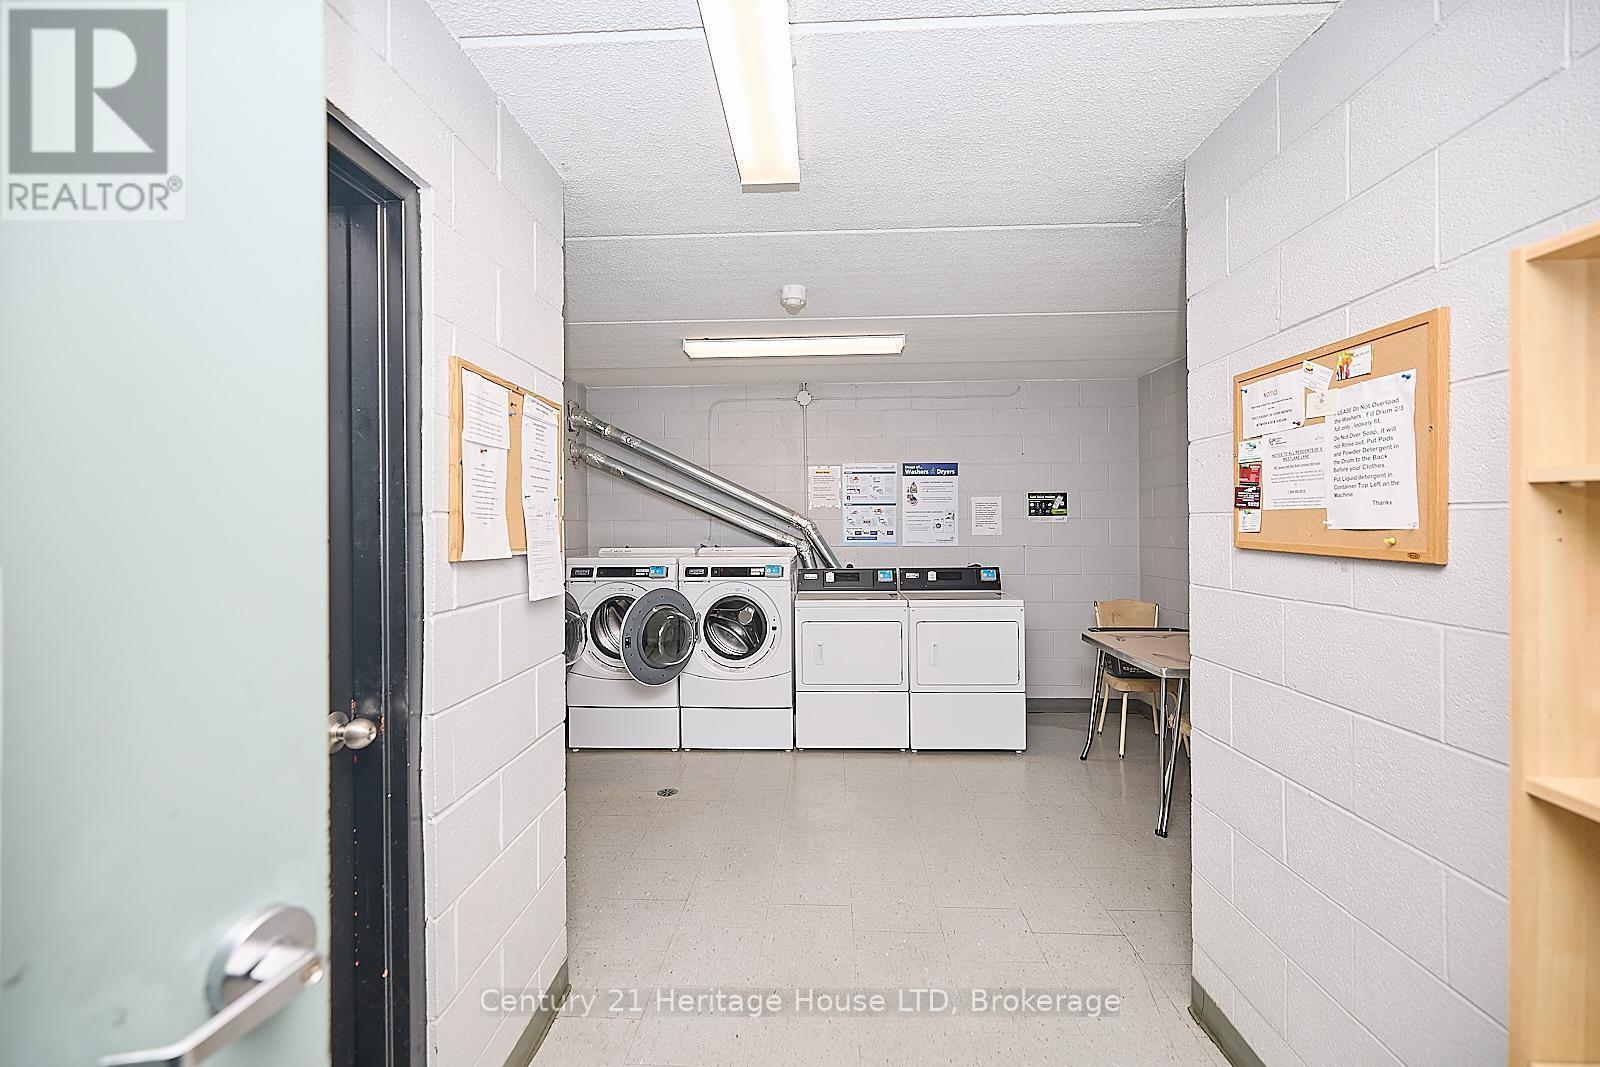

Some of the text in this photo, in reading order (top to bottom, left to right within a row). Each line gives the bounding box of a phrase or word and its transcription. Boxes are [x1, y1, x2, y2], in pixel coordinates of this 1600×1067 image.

[1371, 397, 1400, 408] Overload
[1375, 408, 1393, 416] Drum
[1378, 435, 1394, 443] Pods
[1362, 444, 1393, 453] Detergent
[1372, 453, 1388, 461] Back
[905, 468, 929, 476] Washers
[936, 468, 956, 476] Dryers
[1349, 465, 1361, 473] your
[1341, 474, 1357, 483] Liquid
[1357, 472, 1387, 481] detergent
[1333, 483, 1357, 491] Container
[1357, 482, 1369, 490] Top
[1370, 480, 1381, 488] Left
[1390, 479, 1400, 487] the
[1372, 499, 1393, 507] Thanks
